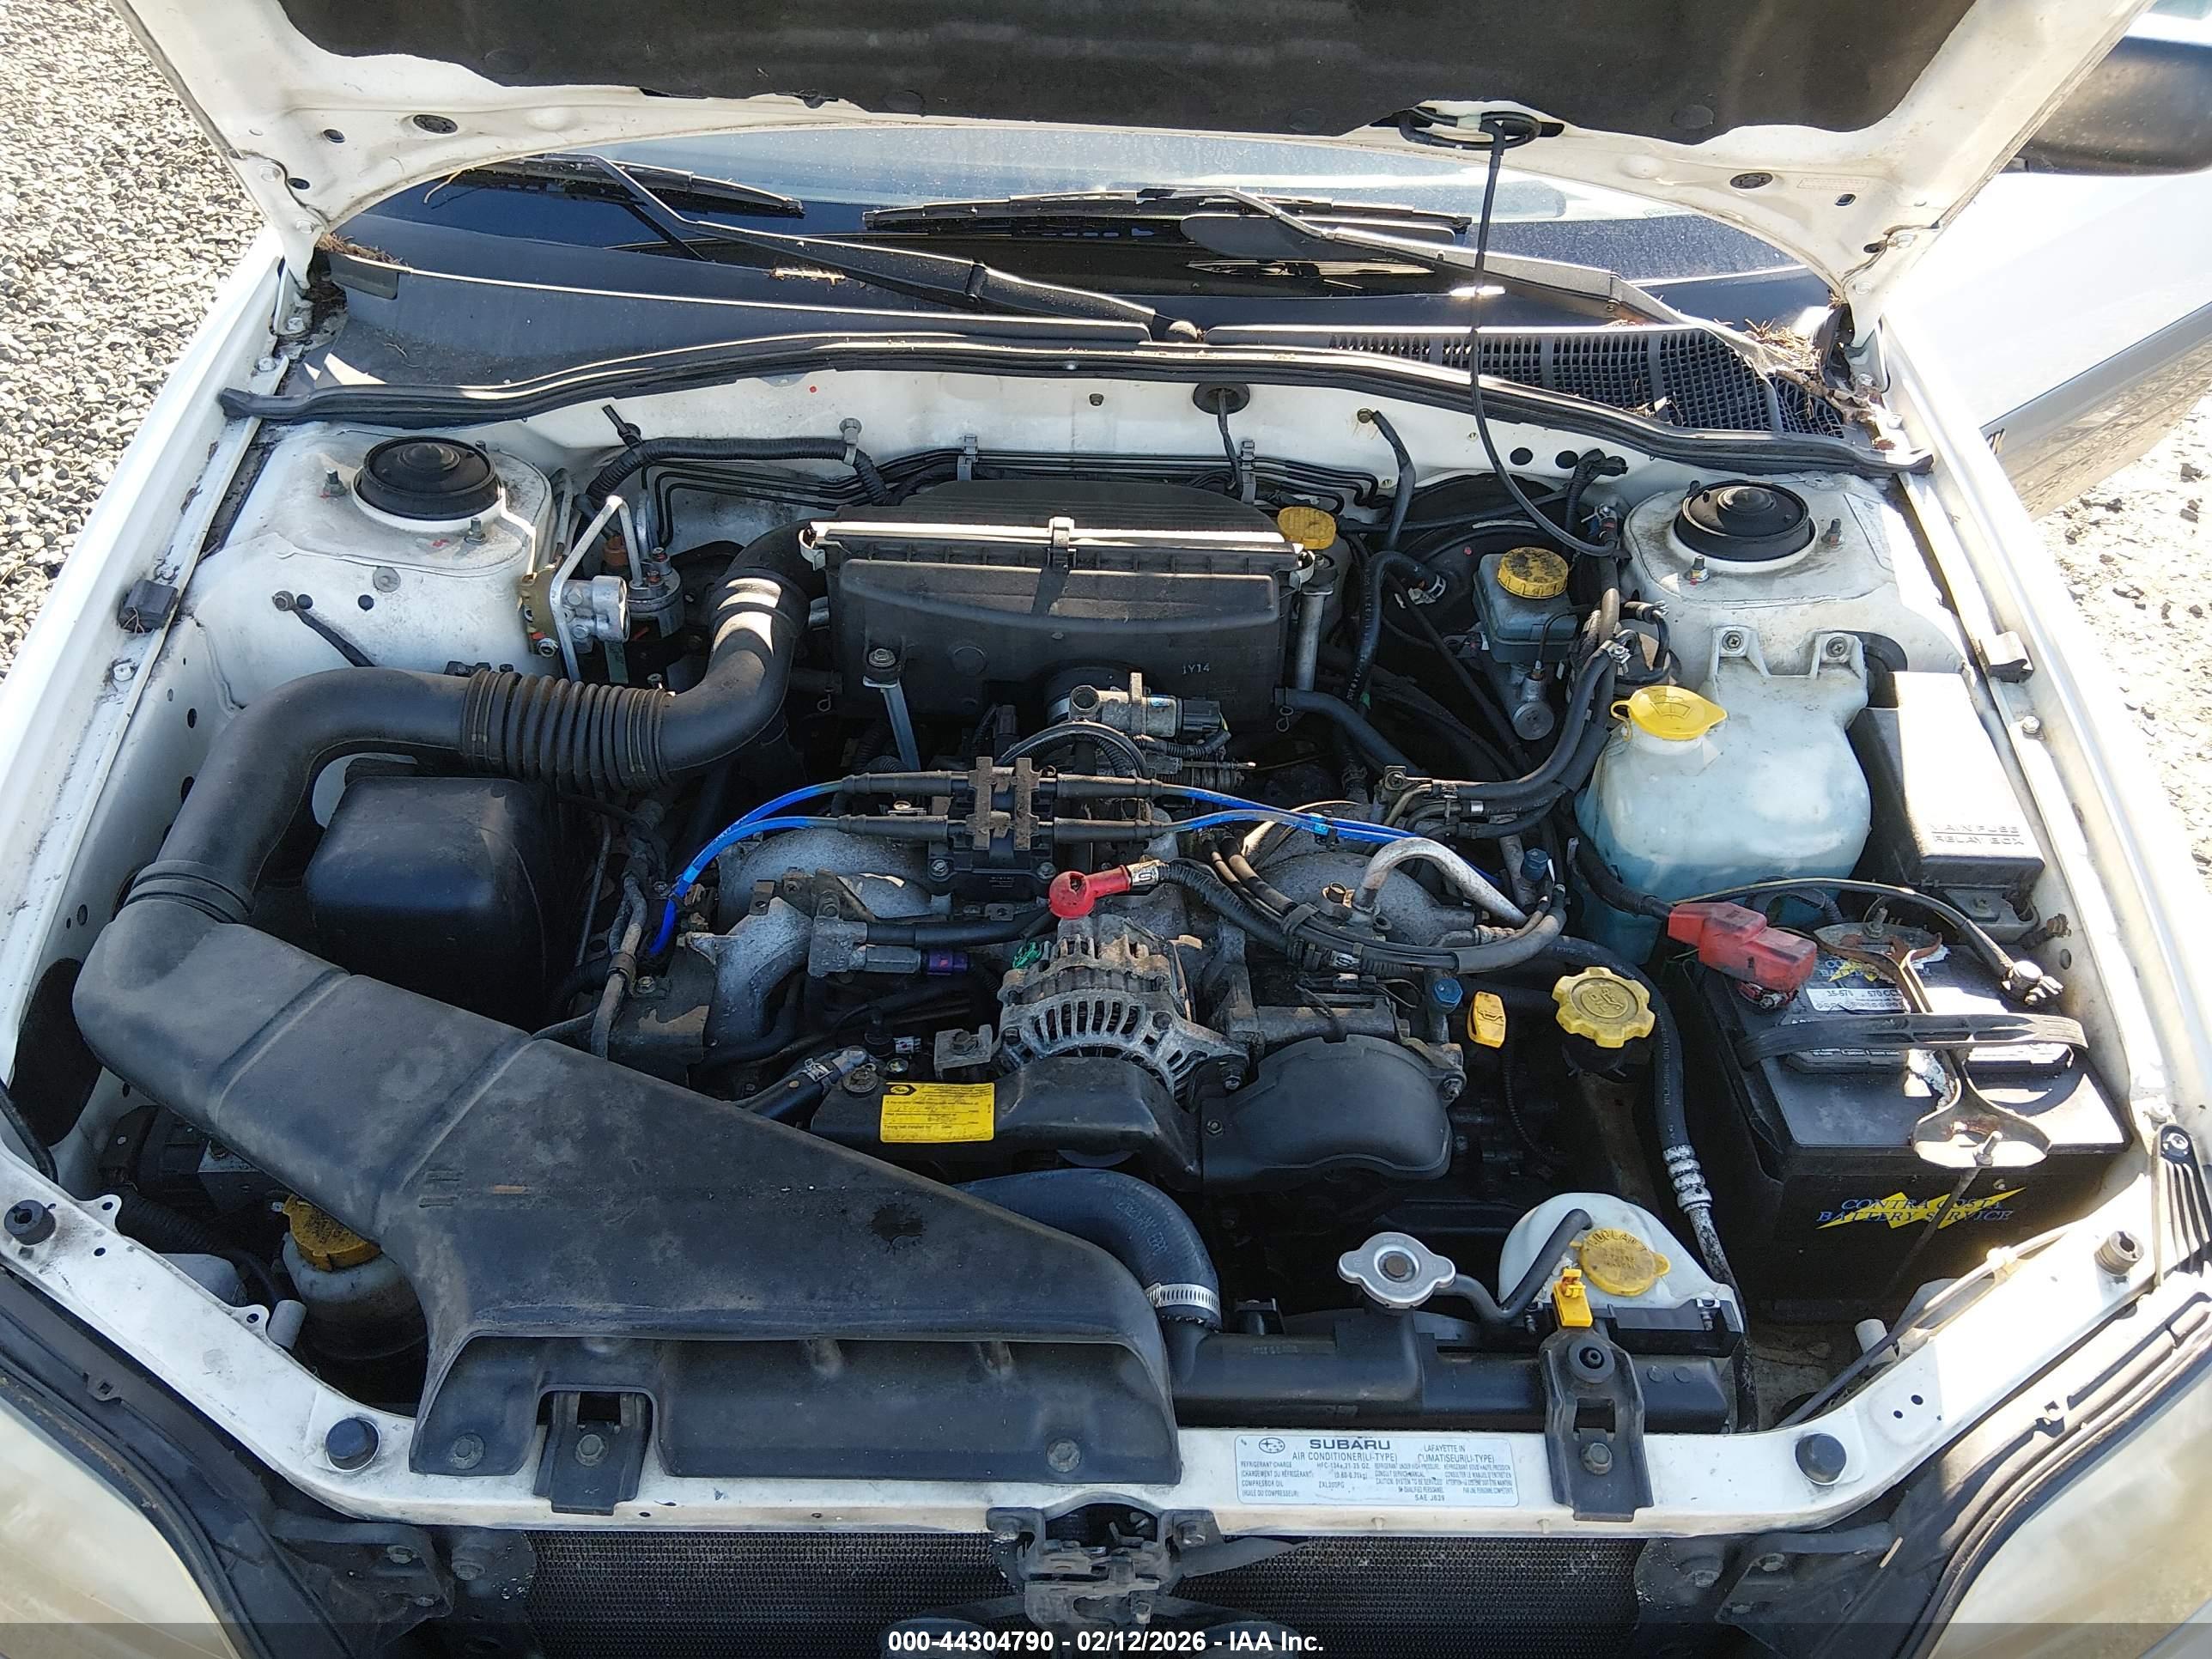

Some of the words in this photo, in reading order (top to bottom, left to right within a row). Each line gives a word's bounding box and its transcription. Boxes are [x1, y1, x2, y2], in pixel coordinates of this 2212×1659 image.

[1840, 1199, 1928, 1210] CONTRA
[1816, 1211, 1922, 1222] BATTERY
[1926, 1210, 2014, 1223] SRVICE
[1310, 1438, 1391, 1450] SUBARU
[1424, 1444, 1456, 1453] LAFAYETTE
[1291, 1451, 1305, 1461] AIR
[1415, 1493, 1428, 1502] SAE
